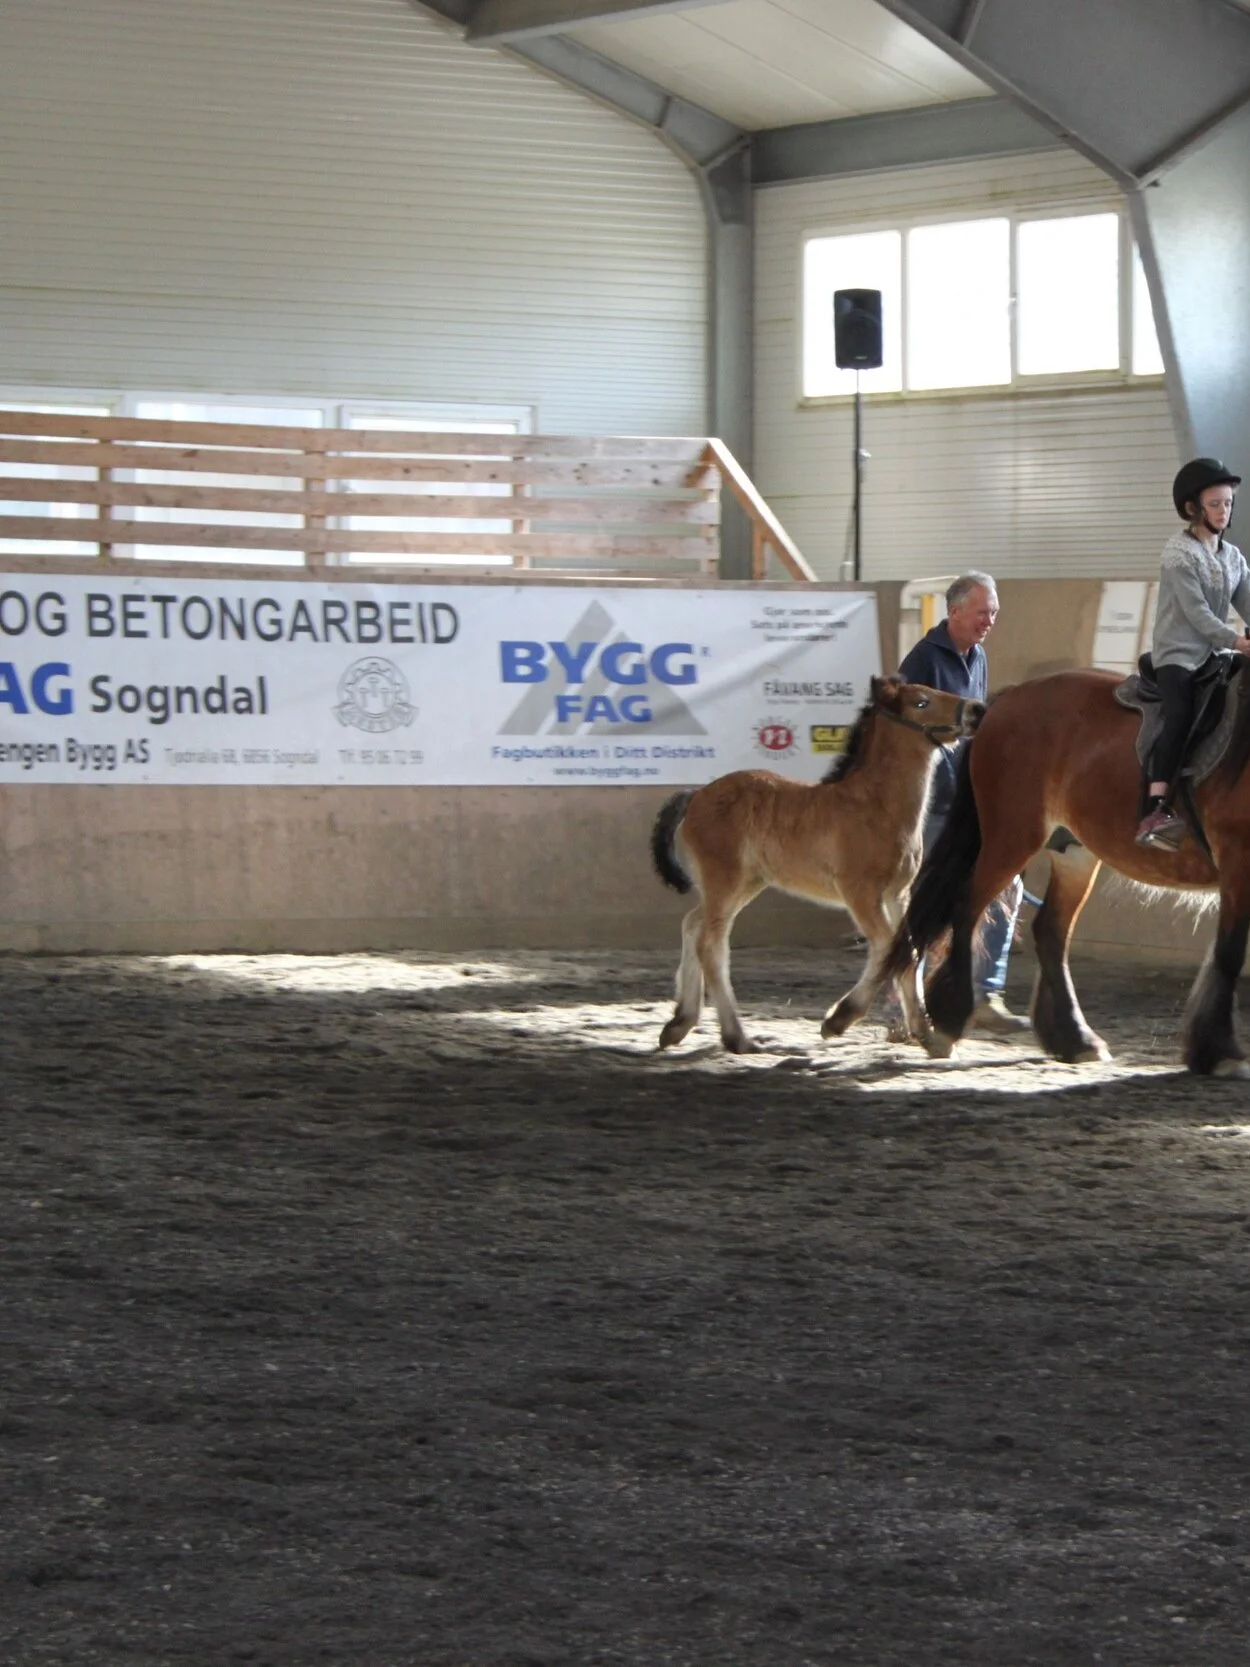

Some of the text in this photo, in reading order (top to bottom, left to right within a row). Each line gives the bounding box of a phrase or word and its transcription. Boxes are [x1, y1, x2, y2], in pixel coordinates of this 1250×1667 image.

[0, 591, 460, 645] OG BETONGARBEID
[499, 640, 697, 685] BYGG
[90, 674, 268, 725] Sogndal
[556, 694, 653, 723] FAG
[65, 737, 117, 770] Bygg
[122, 738, 149, 764] AS
[492, 746, 599, 762] Fagbutikken
[615, 745, 649, 759] Ditt
[652, 745, 716, 759] Distrikt
[553, 765, 660, 779] www.byggfag.no
